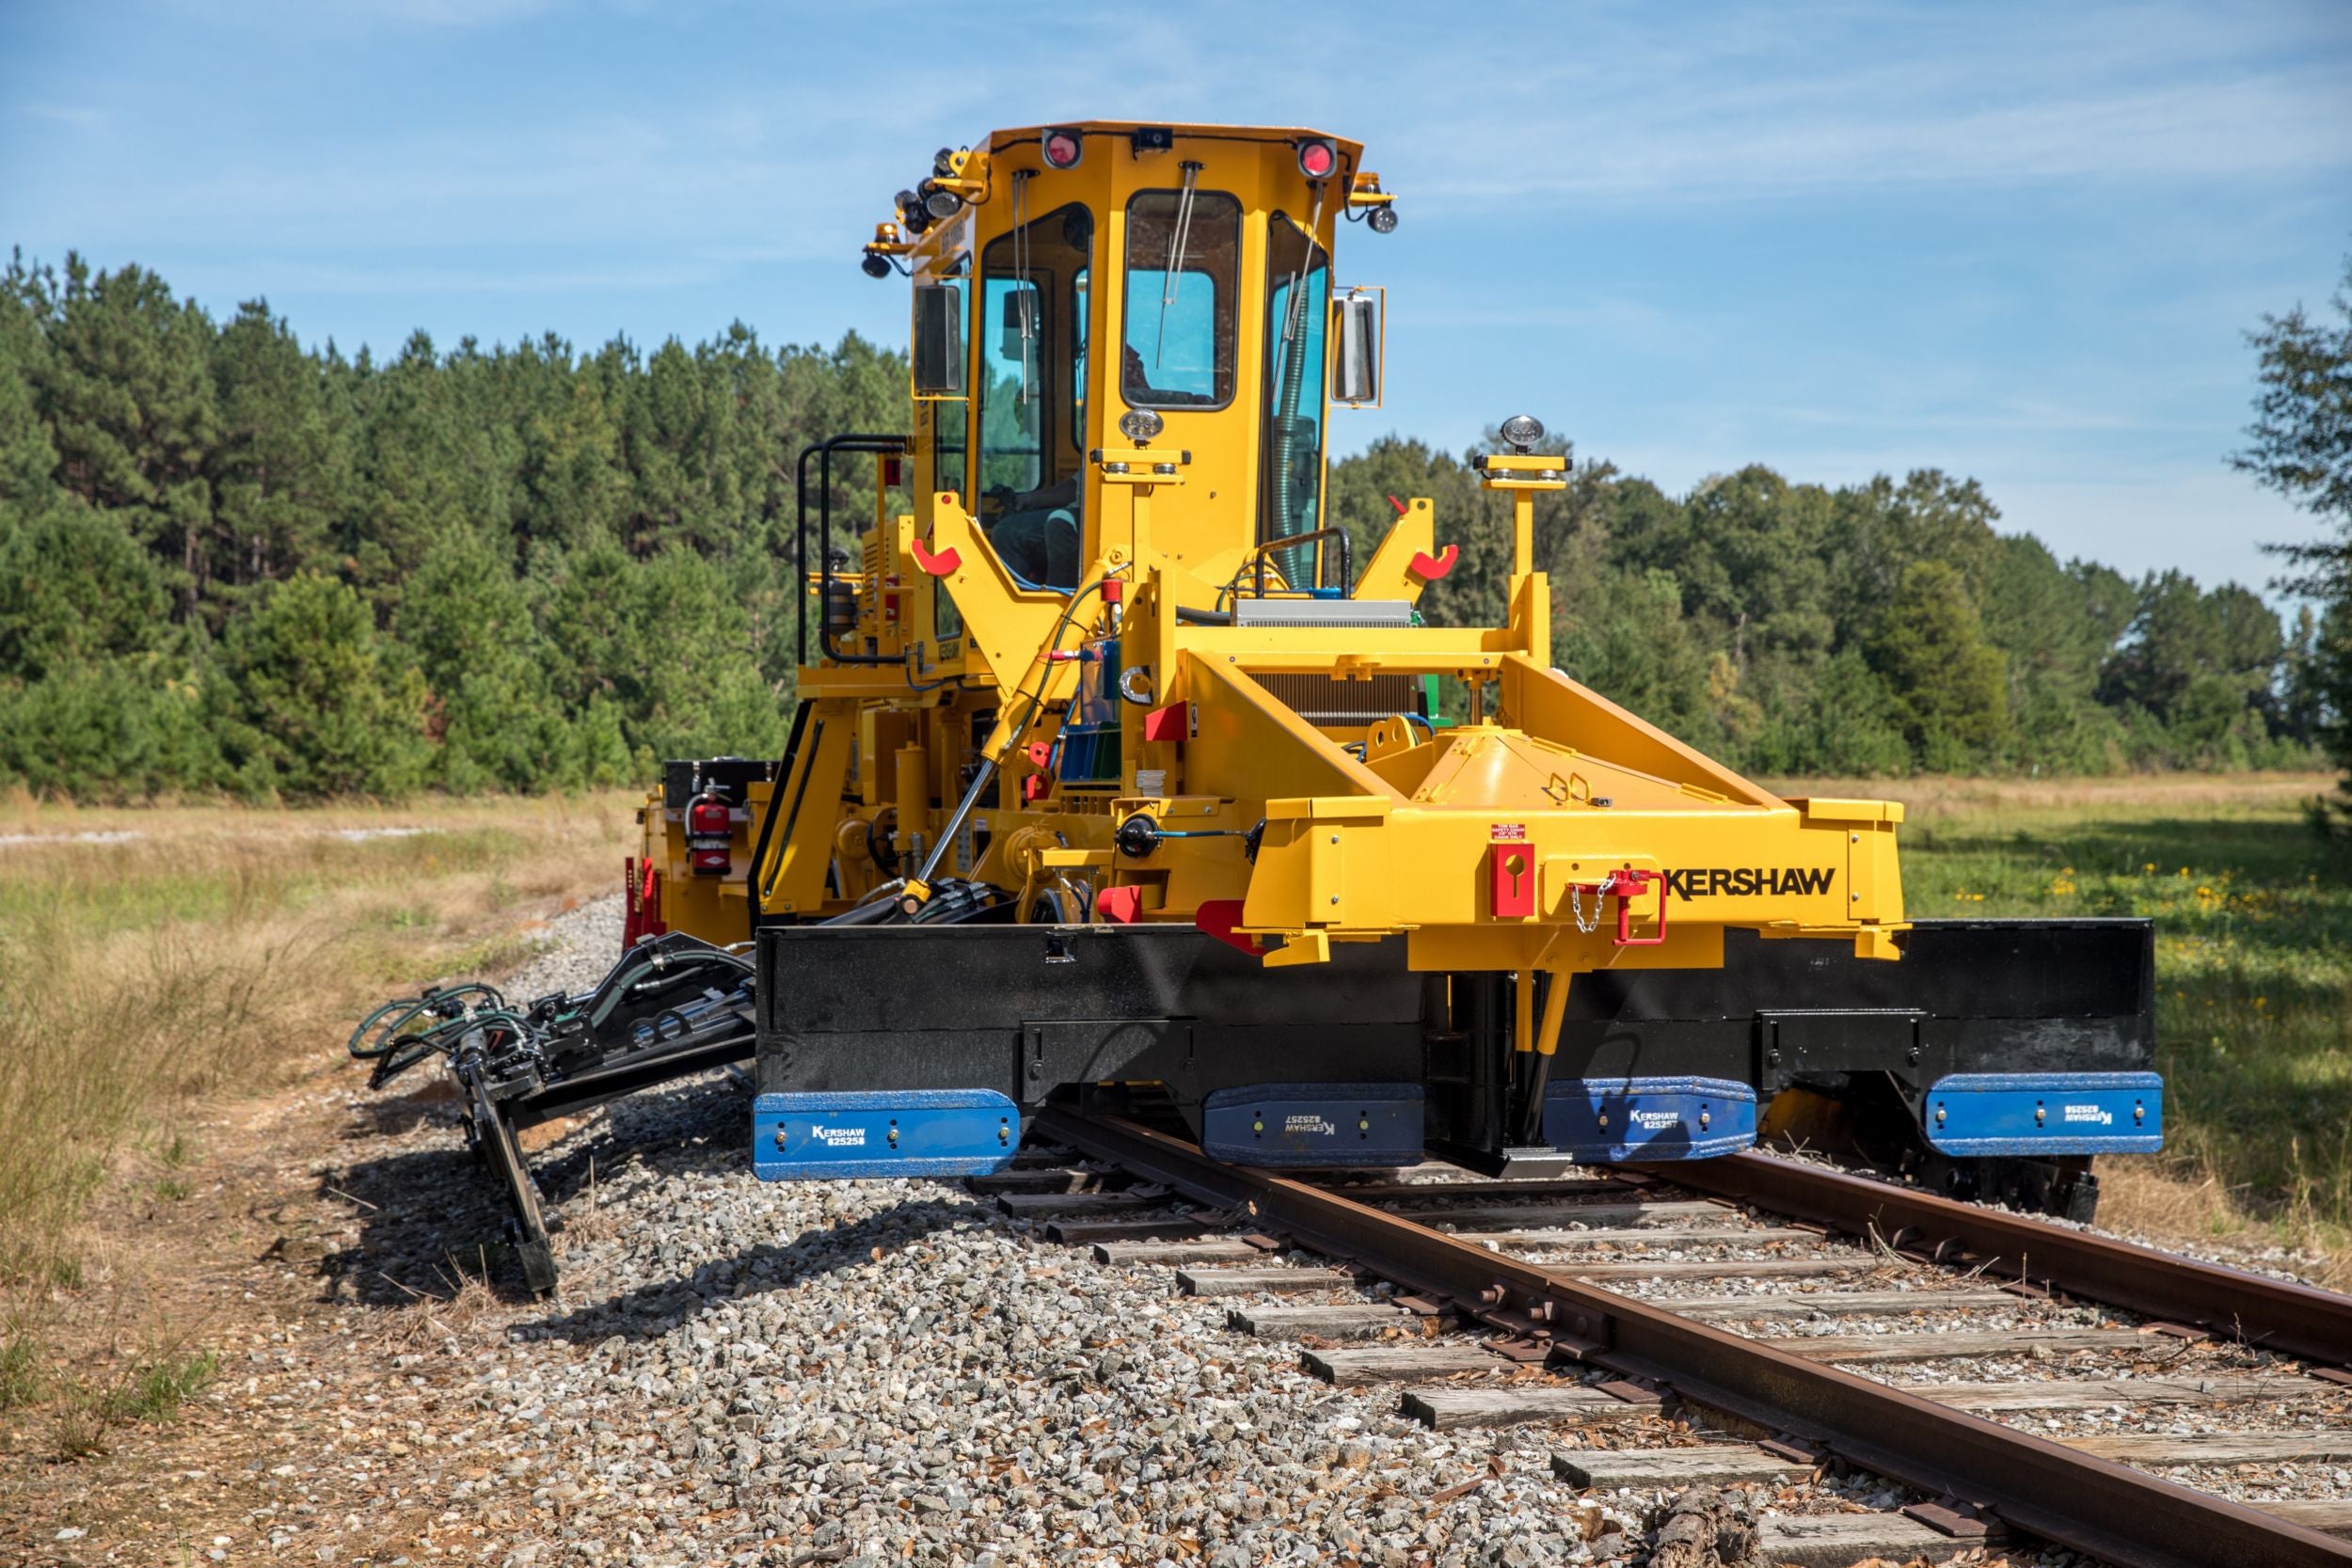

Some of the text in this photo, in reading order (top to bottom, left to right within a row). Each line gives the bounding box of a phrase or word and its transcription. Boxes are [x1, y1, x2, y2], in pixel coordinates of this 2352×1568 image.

[1662, 868, 1836, 901] KERSHAW
[1630, 1109, 1678, 1123] KERSHAW
[2065, 1111, 2112, 1124] KERSHAW
[812, 1125, 866, 1139] KERSHAW
[1285, 1121, 1334, 1134] KERSHAW
